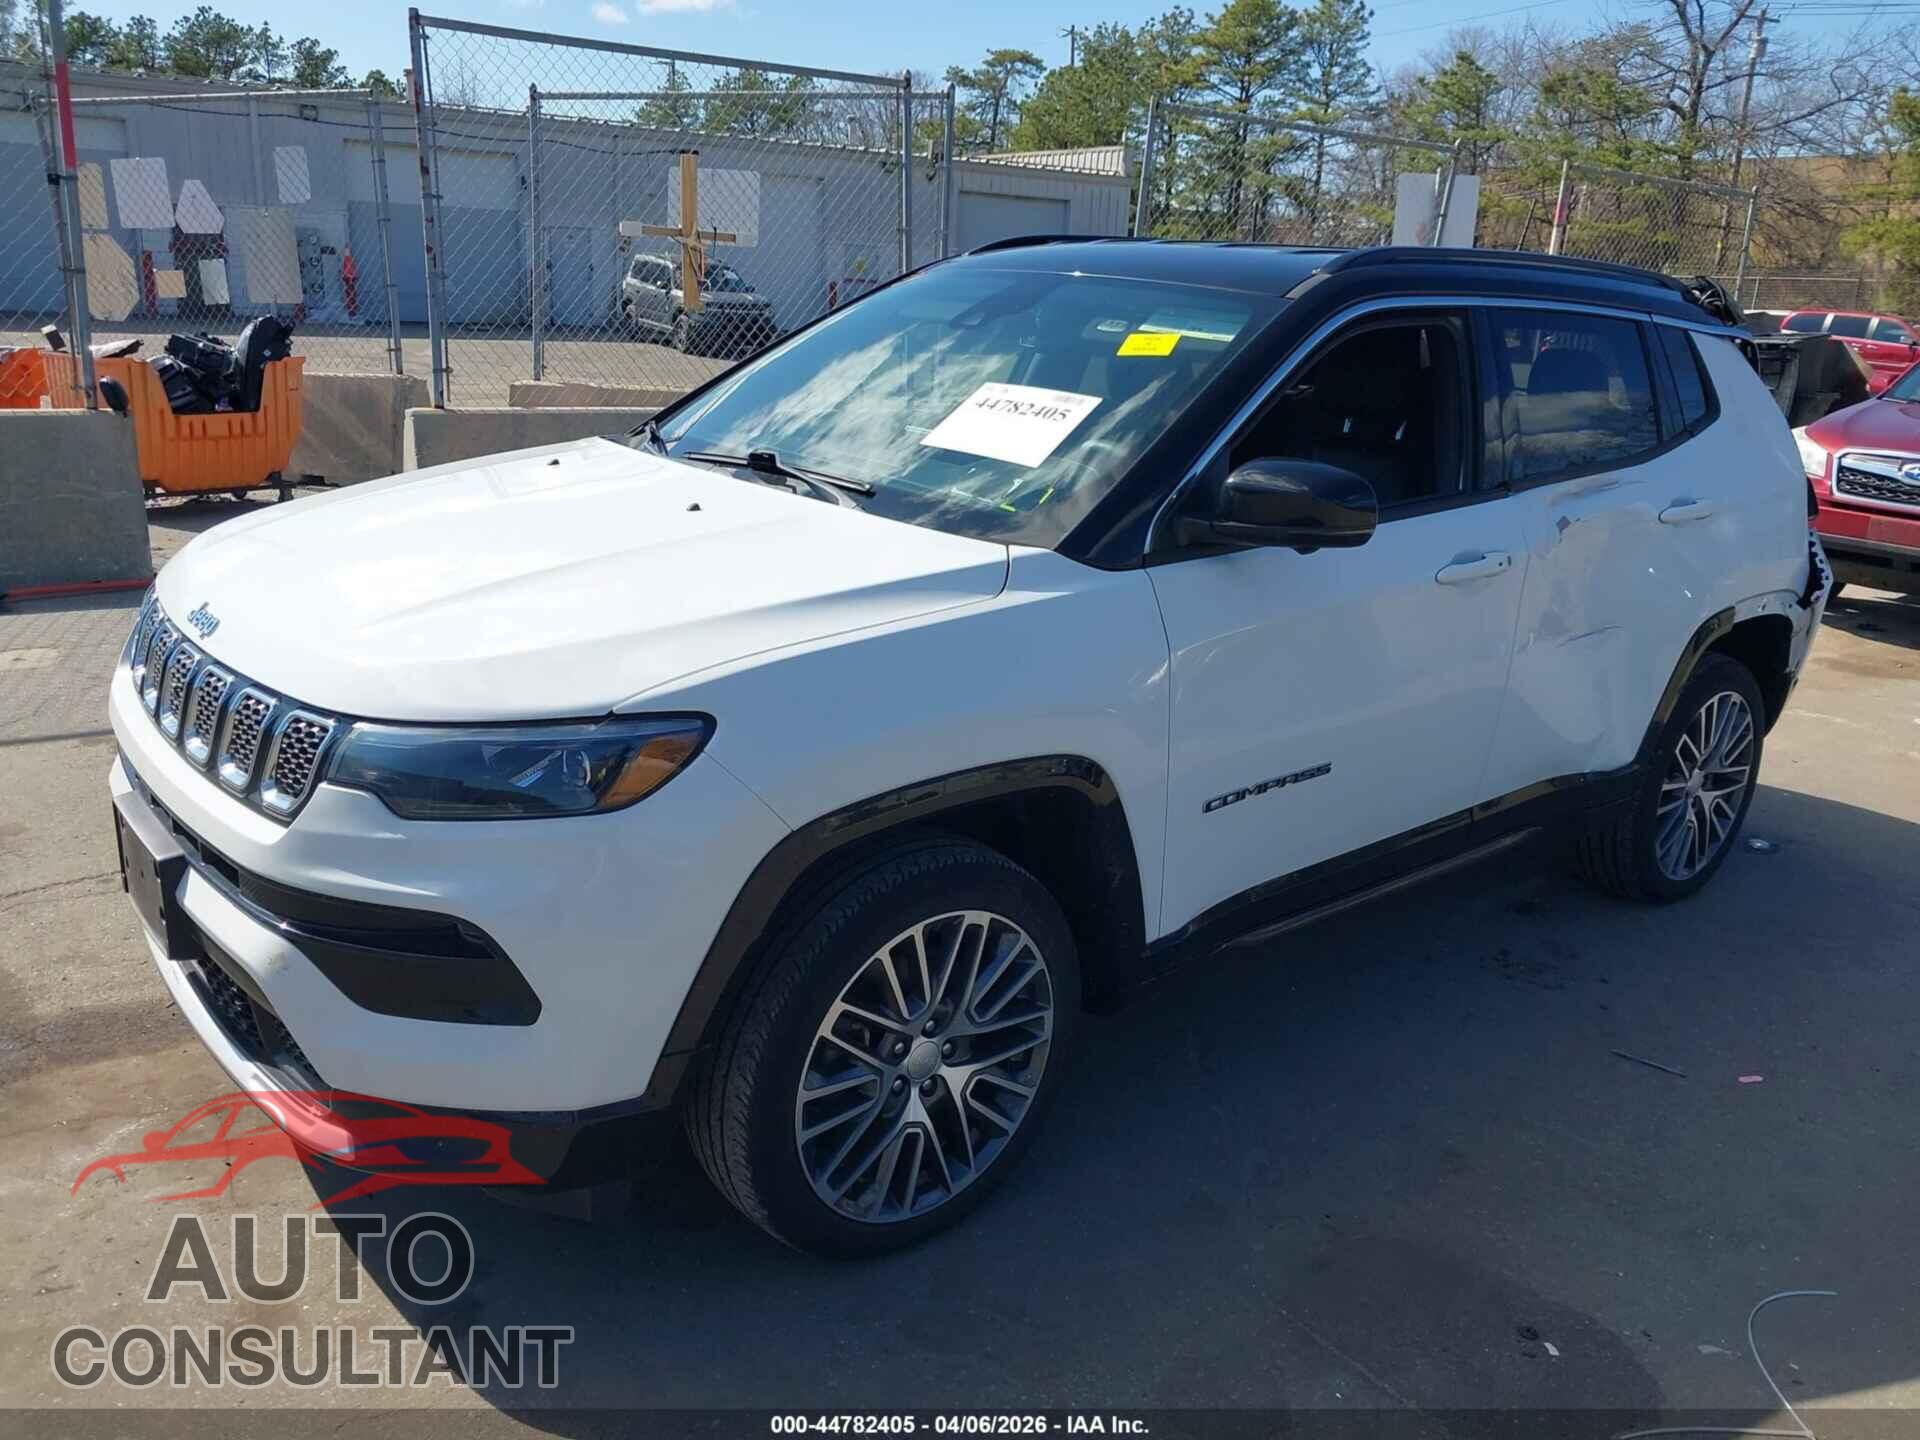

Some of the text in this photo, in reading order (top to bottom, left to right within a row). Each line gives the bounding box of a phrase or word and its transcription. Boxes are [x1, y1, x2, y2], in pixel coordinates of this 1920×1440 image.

[976, 397, 1073, 422] 44782405
[187, 601, 221, 640] Jeep
[1203, 761, 1333, 814] COMPASS
